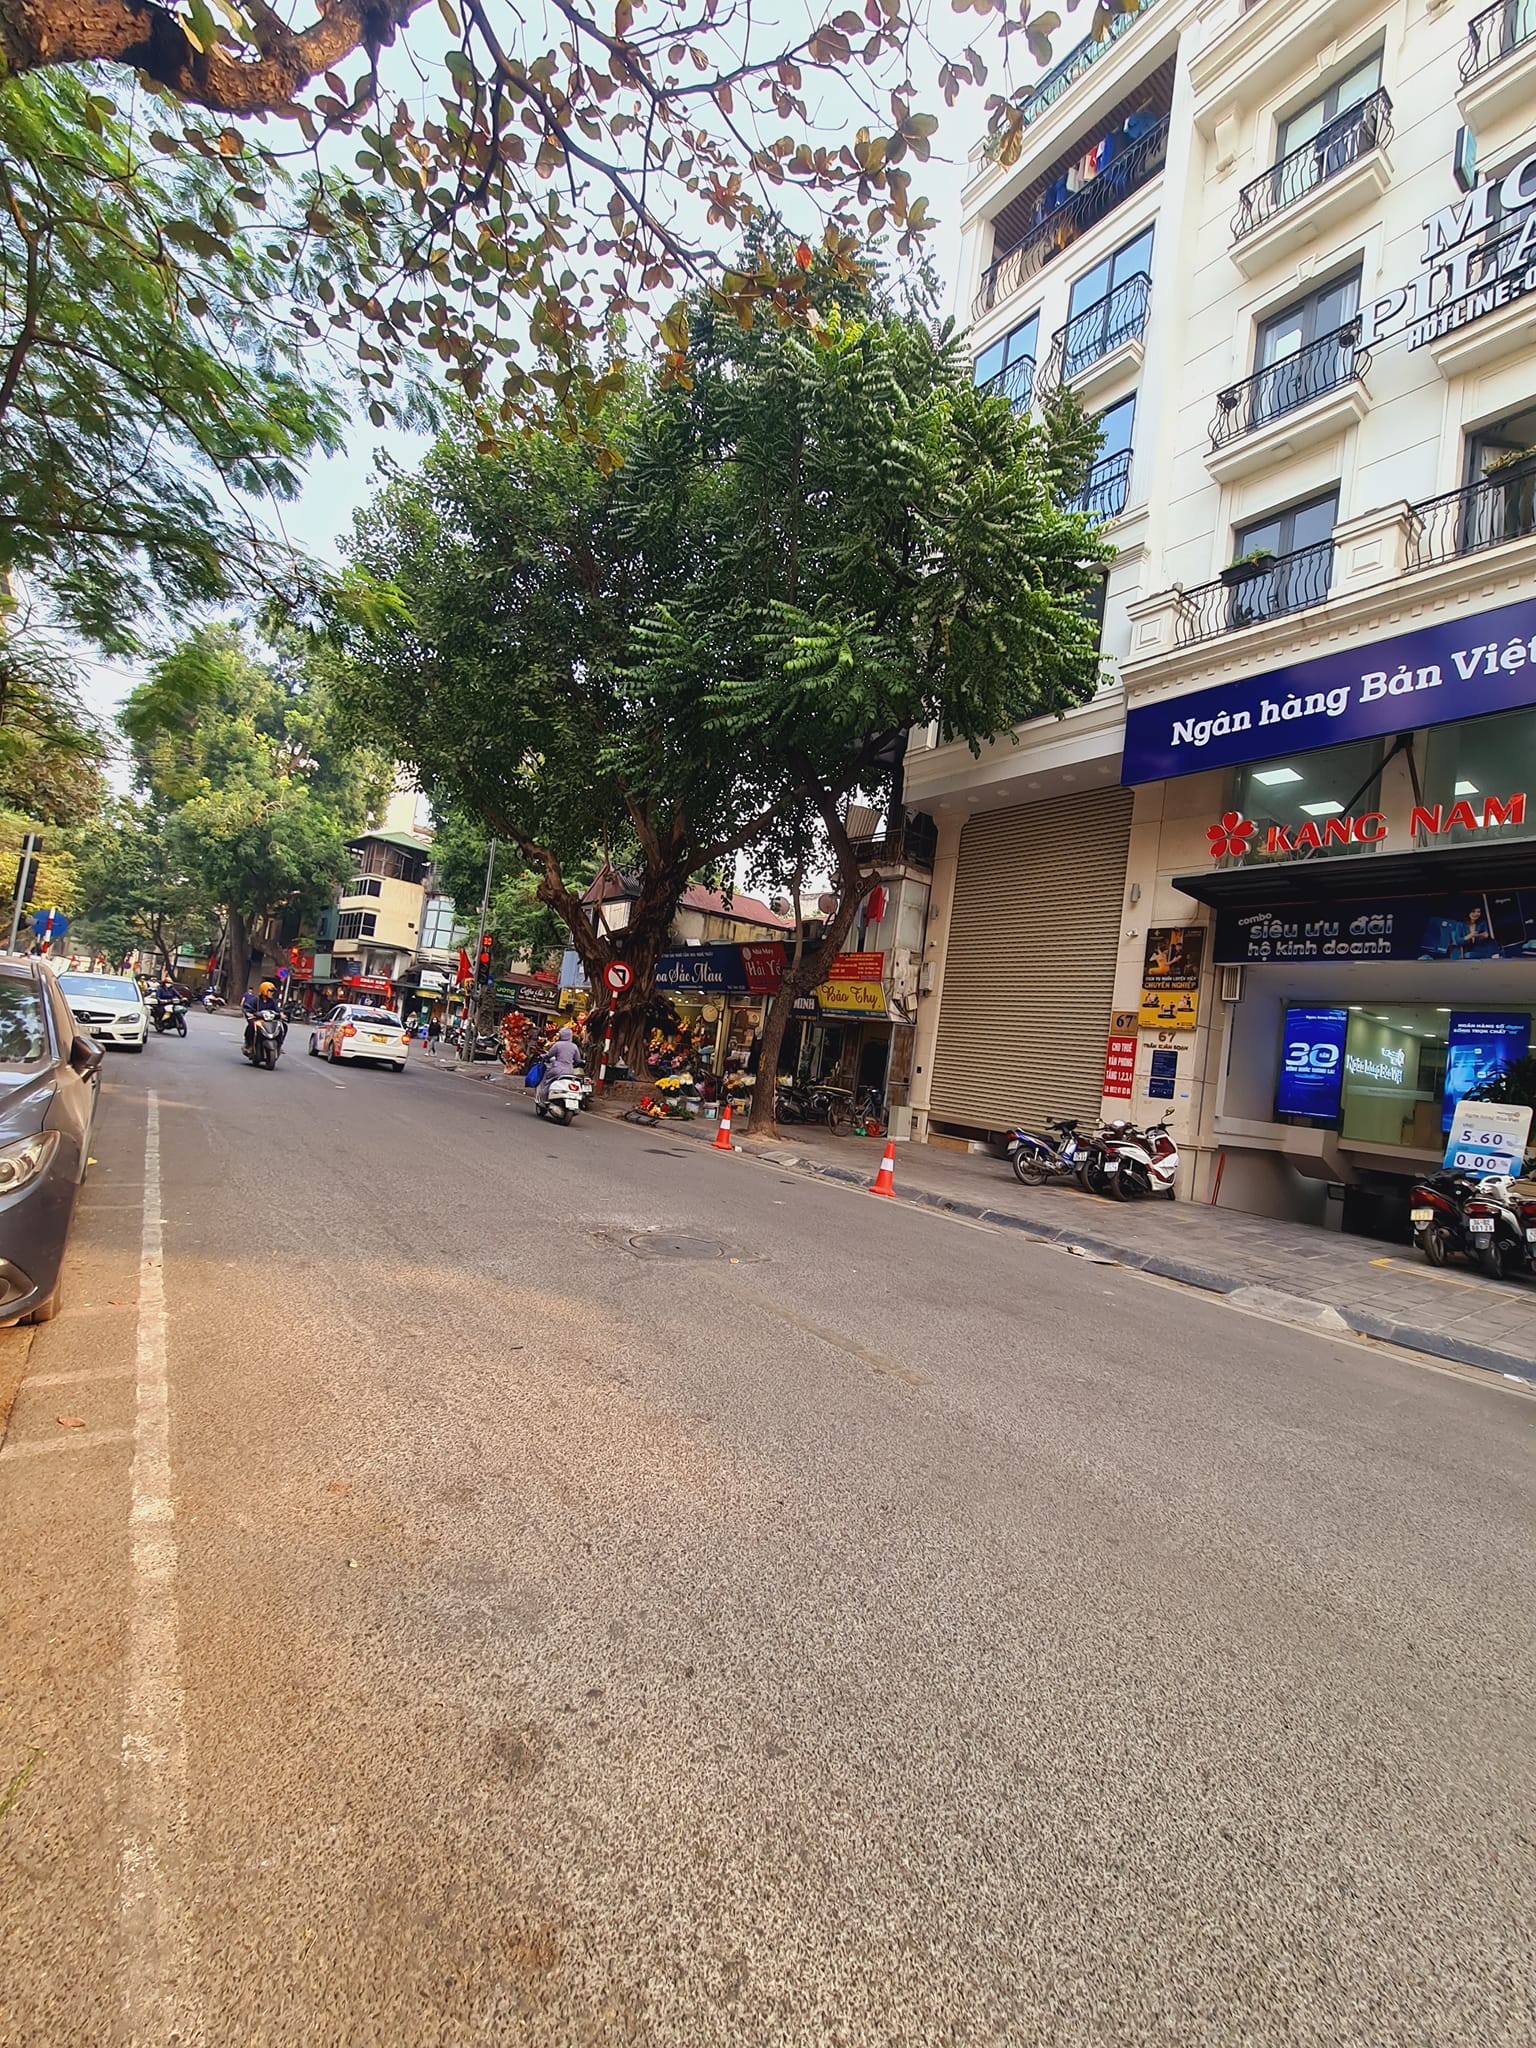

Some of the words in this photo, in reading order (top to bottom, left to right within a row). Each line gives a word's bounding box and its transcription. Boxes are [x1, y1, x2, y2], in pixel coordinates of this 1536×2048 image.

[1171, 711, 1251, 746] Ngân
[1258, 685, 1351, 726] hàng
[1359, 665, 1442, 703] Bản
[1451, 634, 1536, 681] Việt
[1267, 811, 1389, 852] KANG
[1410, 792, 1528, 837] NAM
[1238, 912, 1273, 926] combo
[1249, 919, 1298, 940] siêu
[1304, 920, 1340, 937] ưu
[1349, 913, 1394, 936] đãi
[1247, 940, 1272, 961] hộ
[1275, 939, 1317, 956] kinh
[1322, 937, 1392, 955] doanh
[1116, 1014, 1134, 1029] 67
[1158, 1031, 1177, 1043] 67
[1285, 1042, 1340, 1068] 30
[1461, 1130, 1503, 1146] 5.60
[1456, 1154, 1497, 1170] 0.00
